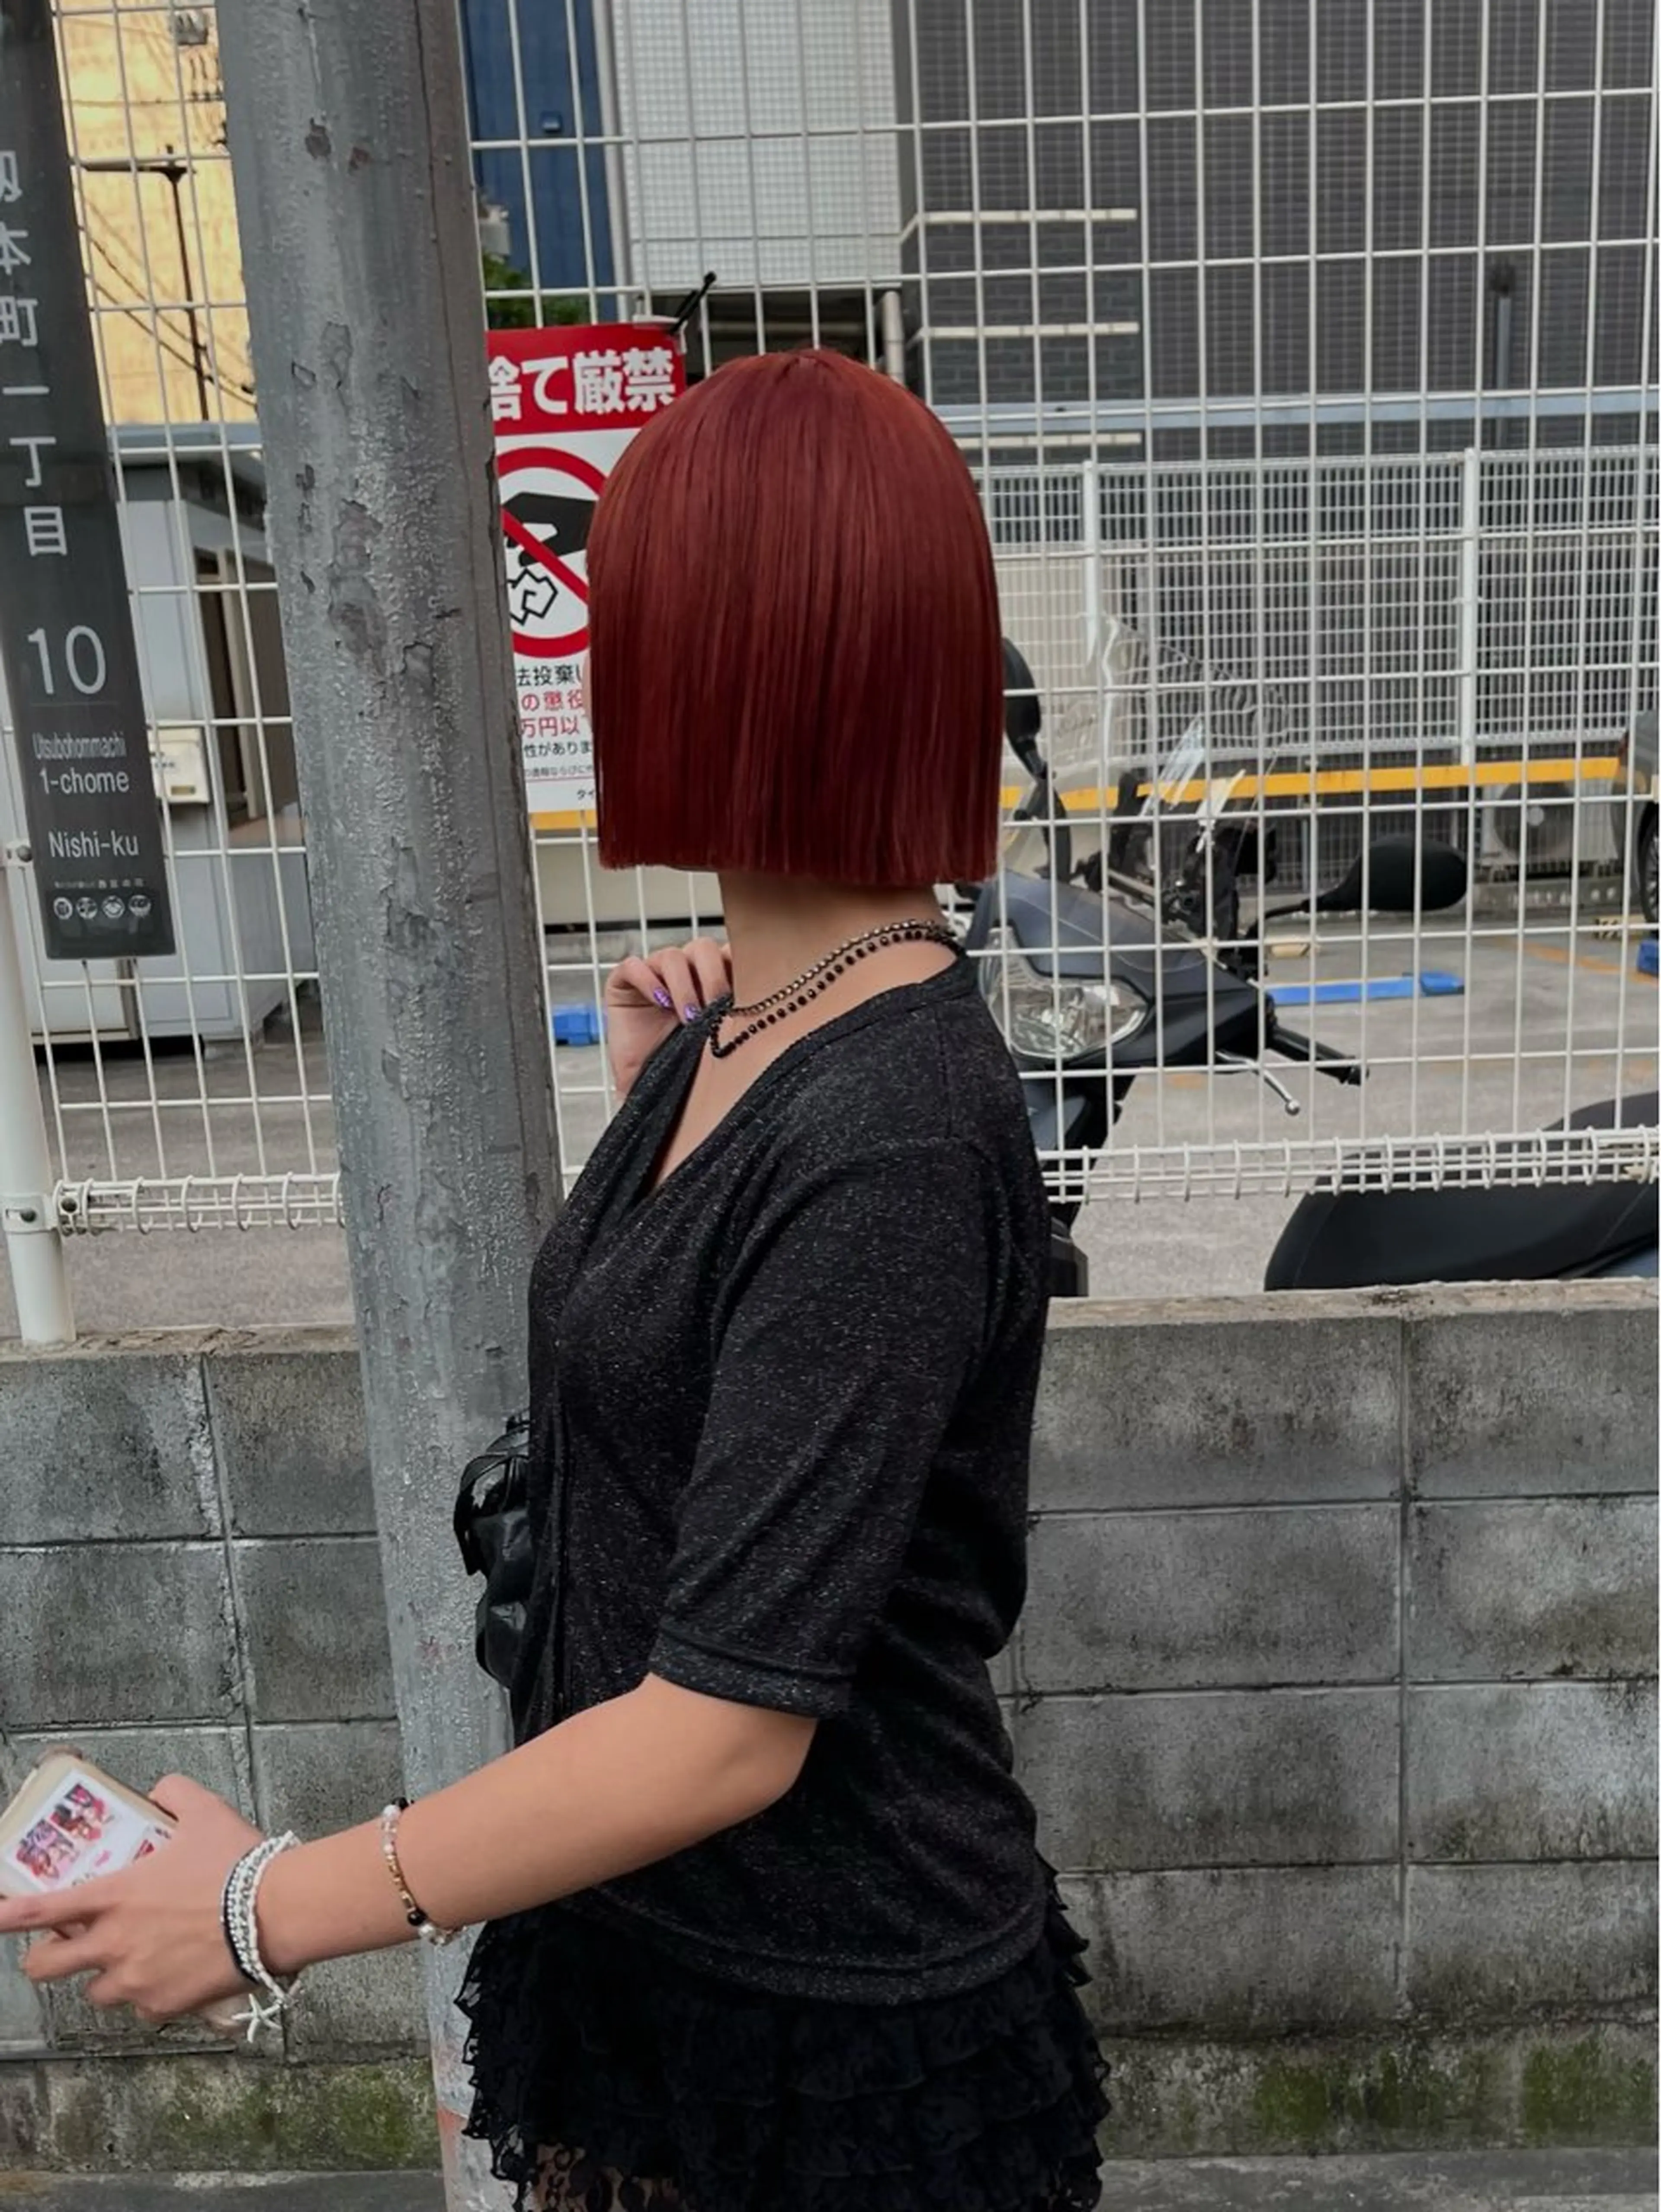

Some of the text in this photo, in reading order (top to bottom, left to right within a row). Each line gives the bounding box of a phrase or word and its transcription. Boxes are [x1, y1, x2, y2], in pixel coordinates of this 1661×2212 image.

[28, 625, 106, 695] 10
[39, 766, 129, 795] 1-chome
[48, 831, 140, 858] Nishi-ku
